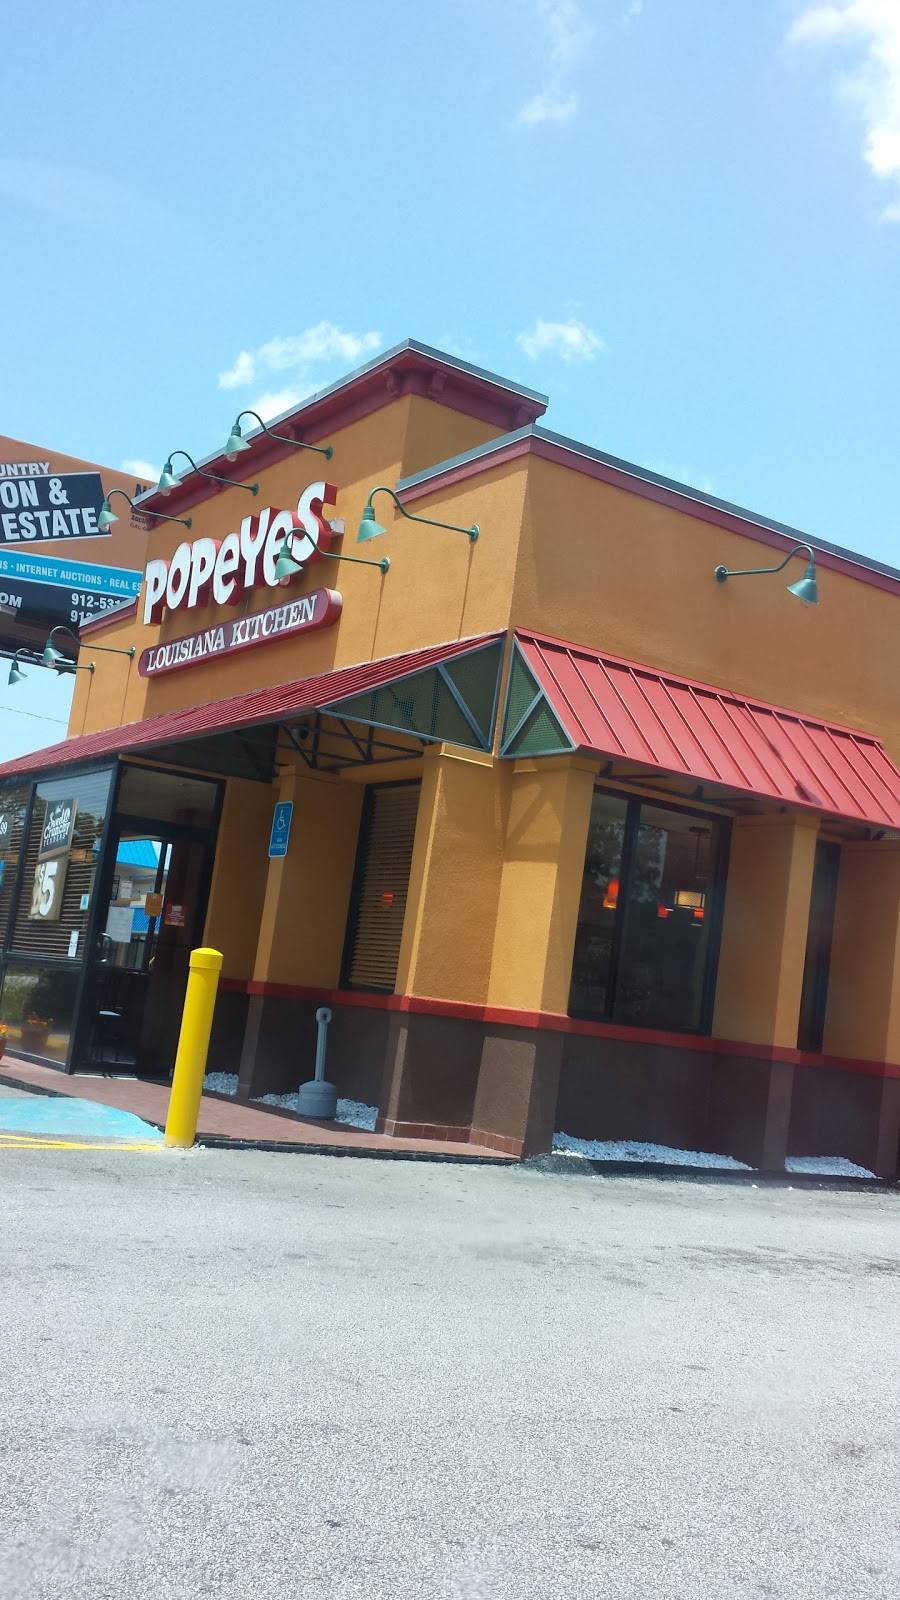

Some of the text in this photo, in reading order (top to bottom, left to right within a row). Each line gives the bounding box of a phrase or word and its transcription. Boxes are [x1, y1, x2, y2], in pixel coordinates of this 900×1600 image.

[0, 478, 70, 509] ON &
[1, 507, 100, 541] ESTATE
[16, 562, 58, 578] INTERNET
[60, 570, 102, 585] AUCTIONS
[109, 577, 130, 590] REAL
[146, 594, 318, 672] LOUISIANA KITCHEN
